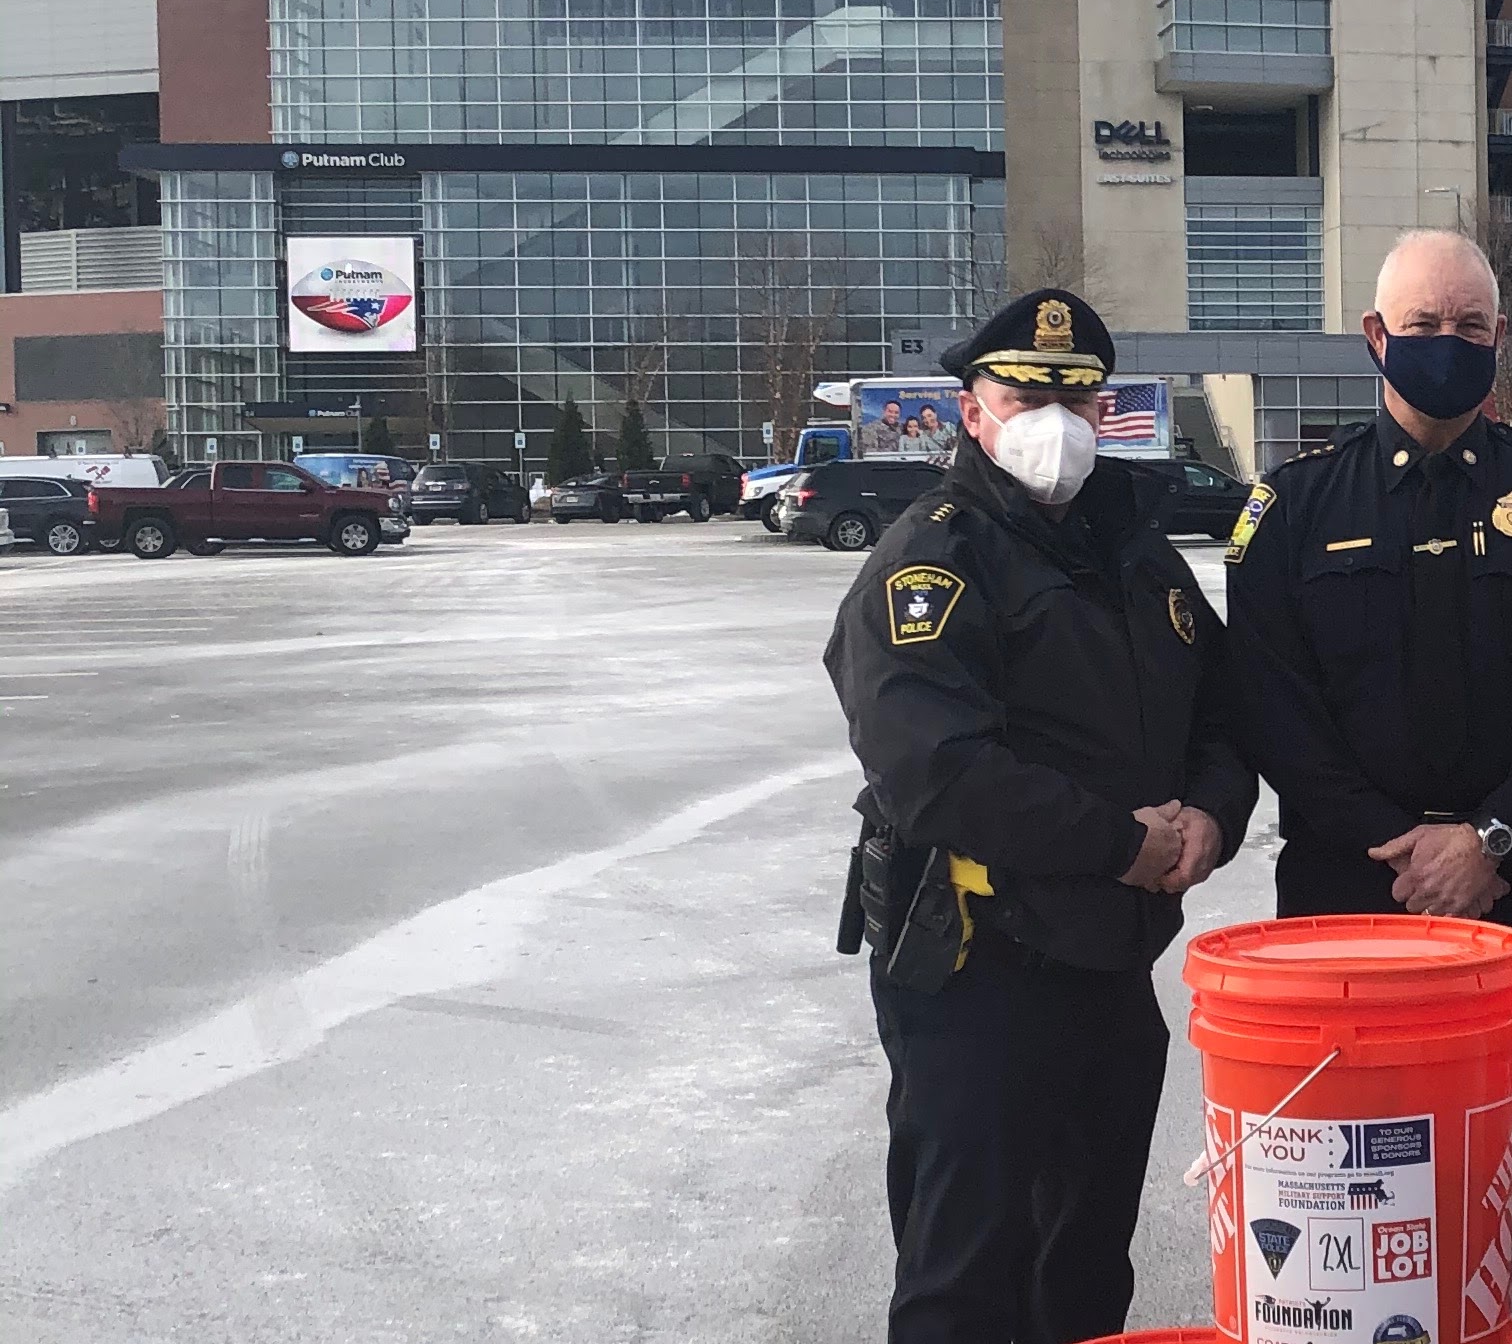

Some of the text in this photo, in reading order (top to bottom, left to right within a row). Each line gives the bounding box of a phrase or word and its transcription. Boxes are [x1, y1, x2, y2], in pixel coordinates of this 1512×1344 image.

[1095, 120, 1170, 145] DELL
[302, 153, 405, 167] Putnam Club
[1099, 149, 1171, 164] Technologies
[336, 270, 383, 279] Putnam
[901, 340, 924, 353] E3
[895, 572, 953, 590] STONEHAM
[901, 621, 933, 635] POLICE
[1246, 1122, 1323, 1144] THANK
[1260, 1143, 1306, 1161] YOU
[1278, 1180, 1345, 1191] MASSACHUSETTS
[1278, 1198, 1345, 1210] FOUNDATION
[1259, 1233, 1290, 1247] STATE
[1376, 1230, 1428, 1256] JOB
[1319, 1233, 1360, 1273] 2XL
[1377, 1253, 1427, 1280] LOT
